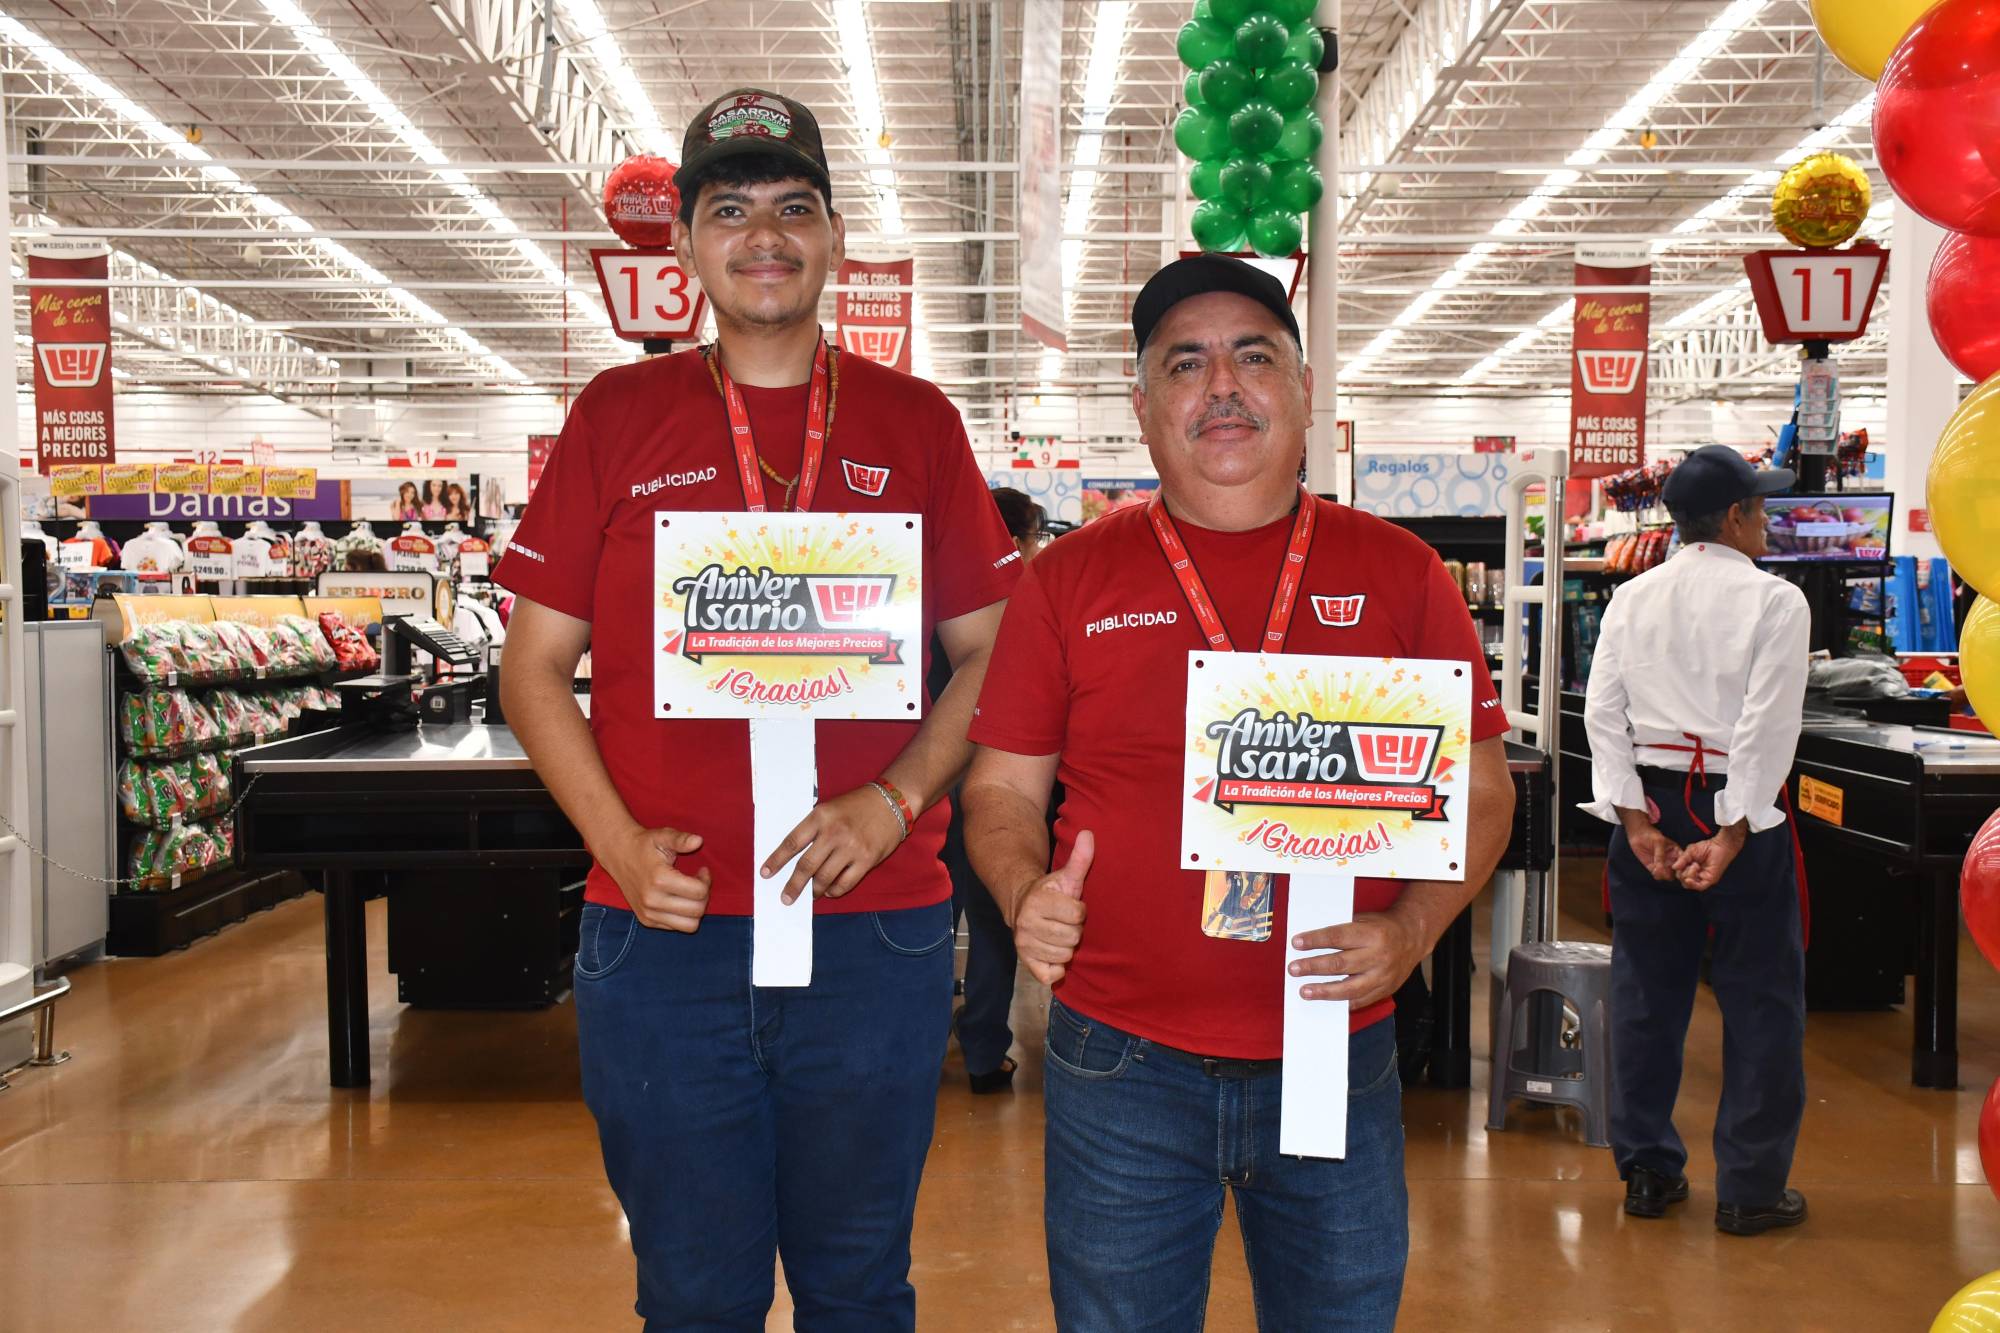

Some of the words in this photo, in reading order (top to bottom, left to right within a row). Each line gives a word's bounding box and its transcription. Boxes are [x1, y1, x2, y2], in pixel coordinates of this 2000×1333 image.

[619, 266, 690, 321] 13
[1792, 268, 1852, 321] 11
[34, 293, 63, 315] Más
[66, 294, 102, 309] cerca
[847, 302, 902, 317] PRECIOS
[53, 310, 67, 327] de
[43, 409, 67, 424] MÁS
[69, 411, 104, 425] COSAS
[1576, 415, 1600, 430] MÁS
[1602, 417, 1637, 431] COSAS
[42, 426, 50, 441] A
[53, 426, 106, 441] MEJORES
[1574, 431, 1583, 447] A
[1586, 431, 1638, 447] MEJORES
[42, 442, 108, 458] PRECIOS
[198, 451, 217, 465] 12
[414, 451, 429, 465] 11
[1041, 451, 1051, 465] 9
[1574, 447, 1638, 463] PRECIOS
[1368, 460, 1430, 476] Regalos
[631, 467, 717, 498] PUBLICIDAD
[148, 493, 291, 517] Damas
[193, 565, 224, 575] $249.90
[326, 587, 425, 600] FERRERO
[676, 567, 800, 627] Aniver
[700, 601, 807, 631] sario
[1086, 611, 1177, 637] PUBLICIDAD
[692, 637, 705, 648] La
[708, 636, 758, 648] Tradición
[761, 637, 774, 648] de
[777, 637, 794, 648] los
[795, 637, 840, 650] Mejores
[842, 638, 884, 648] Precios
[715, 668, 852, 702] ¡Gracias!
[1210, 711, 1341, 774] Aniver
[1234, 748, 1347, 781] sario
[1224, 784, 1238, 796] La
[1241, 784, 1295, 798] Tradición
[1297, 786, 1312, 798] de
[1314, 786, 1332, 799] los
[1334, 788, 1381, 803] Mejores
[1384, 790, 1428, 803] Precios
[1246, 819, 1394, 858] ¡Gracias!
